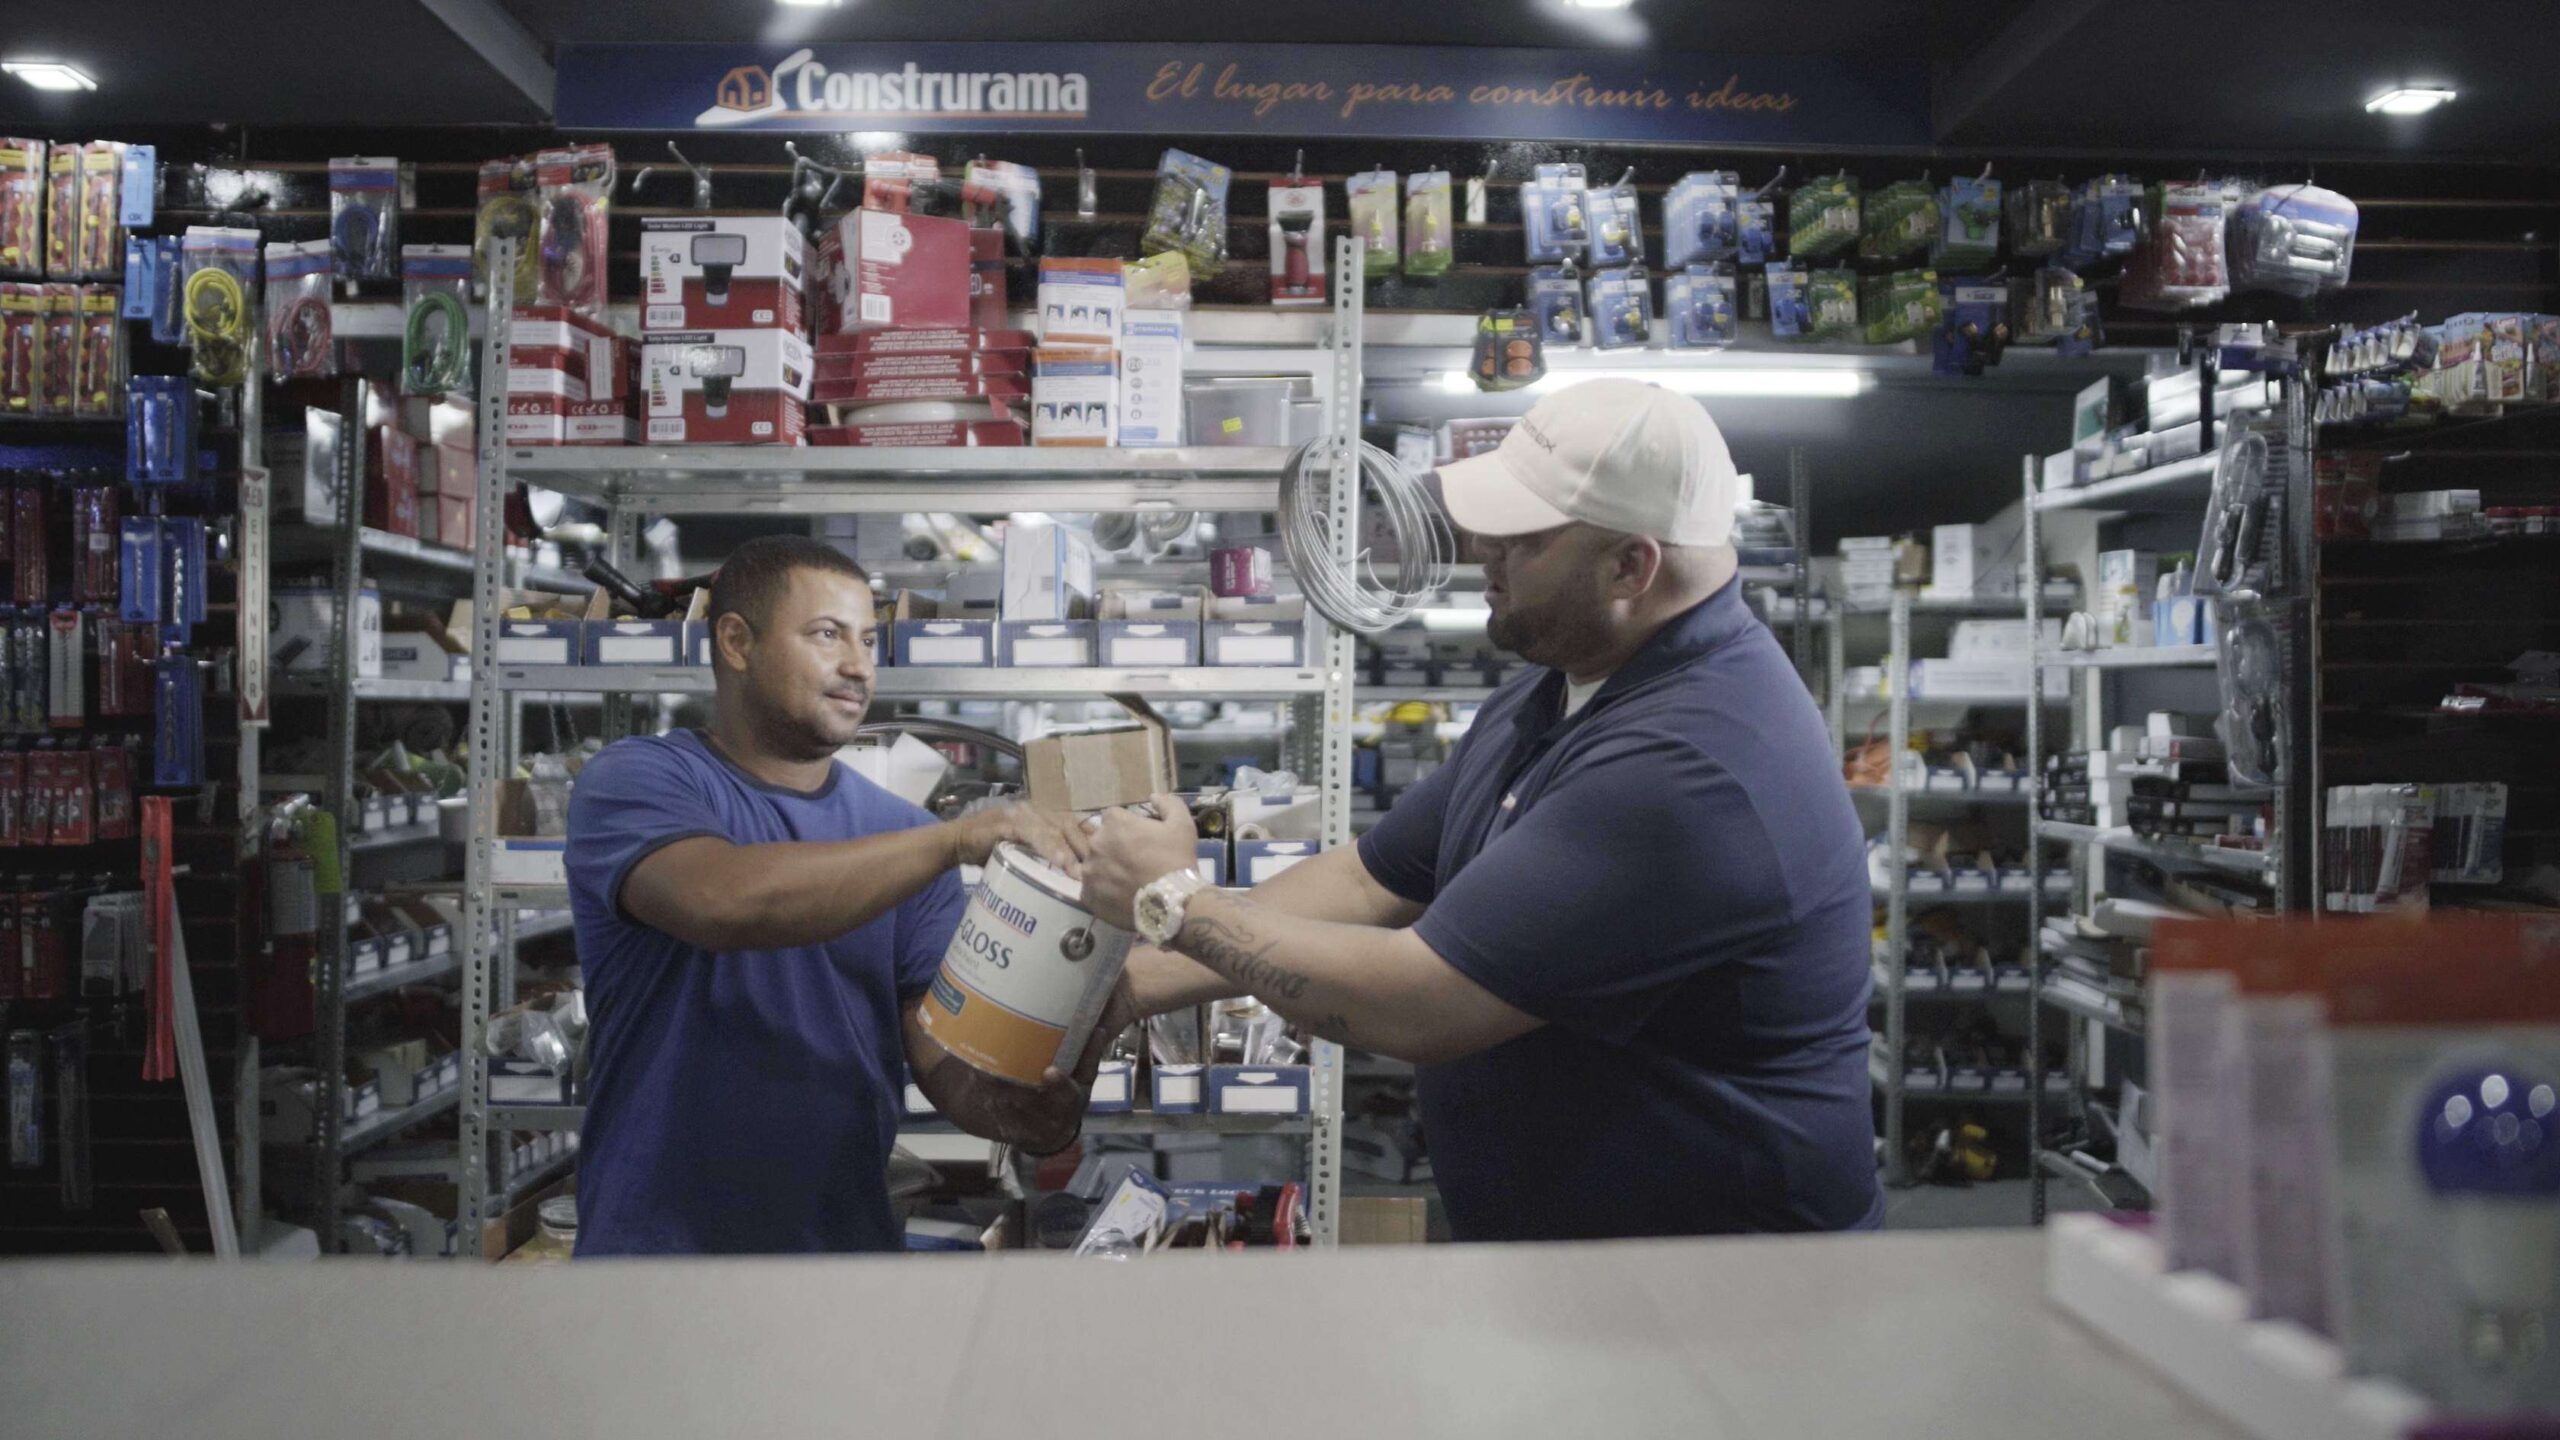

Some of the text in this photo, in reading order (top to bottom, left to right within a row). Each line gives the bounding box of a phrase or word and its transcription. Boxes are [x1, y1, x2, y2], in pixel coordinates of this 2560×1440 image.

[797, 61, 1087, 111] Construrama
[1146, 60, 1798, 118] El lugar para construir ideas
[248, 519, 259, 699] EXTINTOR
